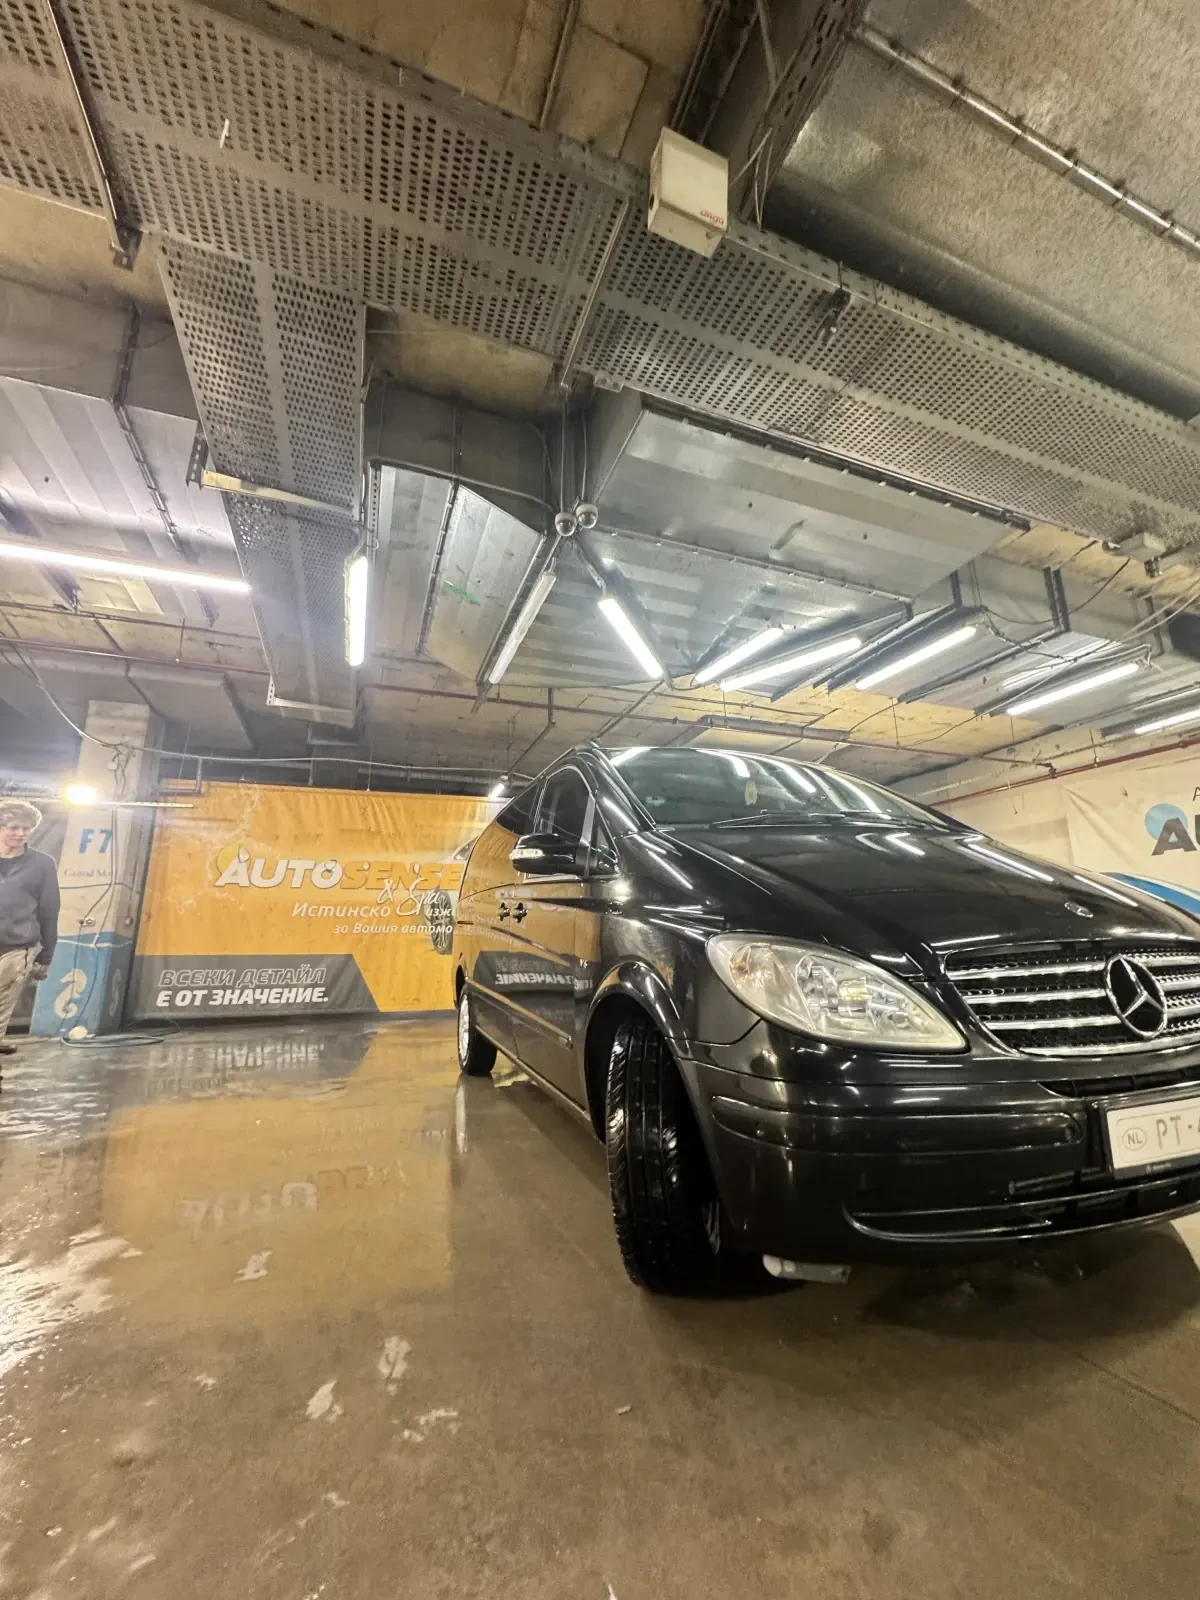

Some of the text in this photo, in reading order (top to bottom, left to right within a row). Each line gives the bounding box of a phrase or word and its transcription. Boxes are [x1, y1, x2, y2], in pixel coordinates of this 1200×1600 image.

[214, 855, 464, 890] AUTOSENSE
[291, 903, 391, 917] Истинско
[333, 925, 347, 934] за
[352, 923, 398, 933] Вашия
[158, 964, 327, 988] ВСЕКИ ДЕТАЙЛ
[156, 987, 329, 1007] Е ОТ ЗНАЧЕНИЕ.
[1127, 1131, 1142, 1145] NL
